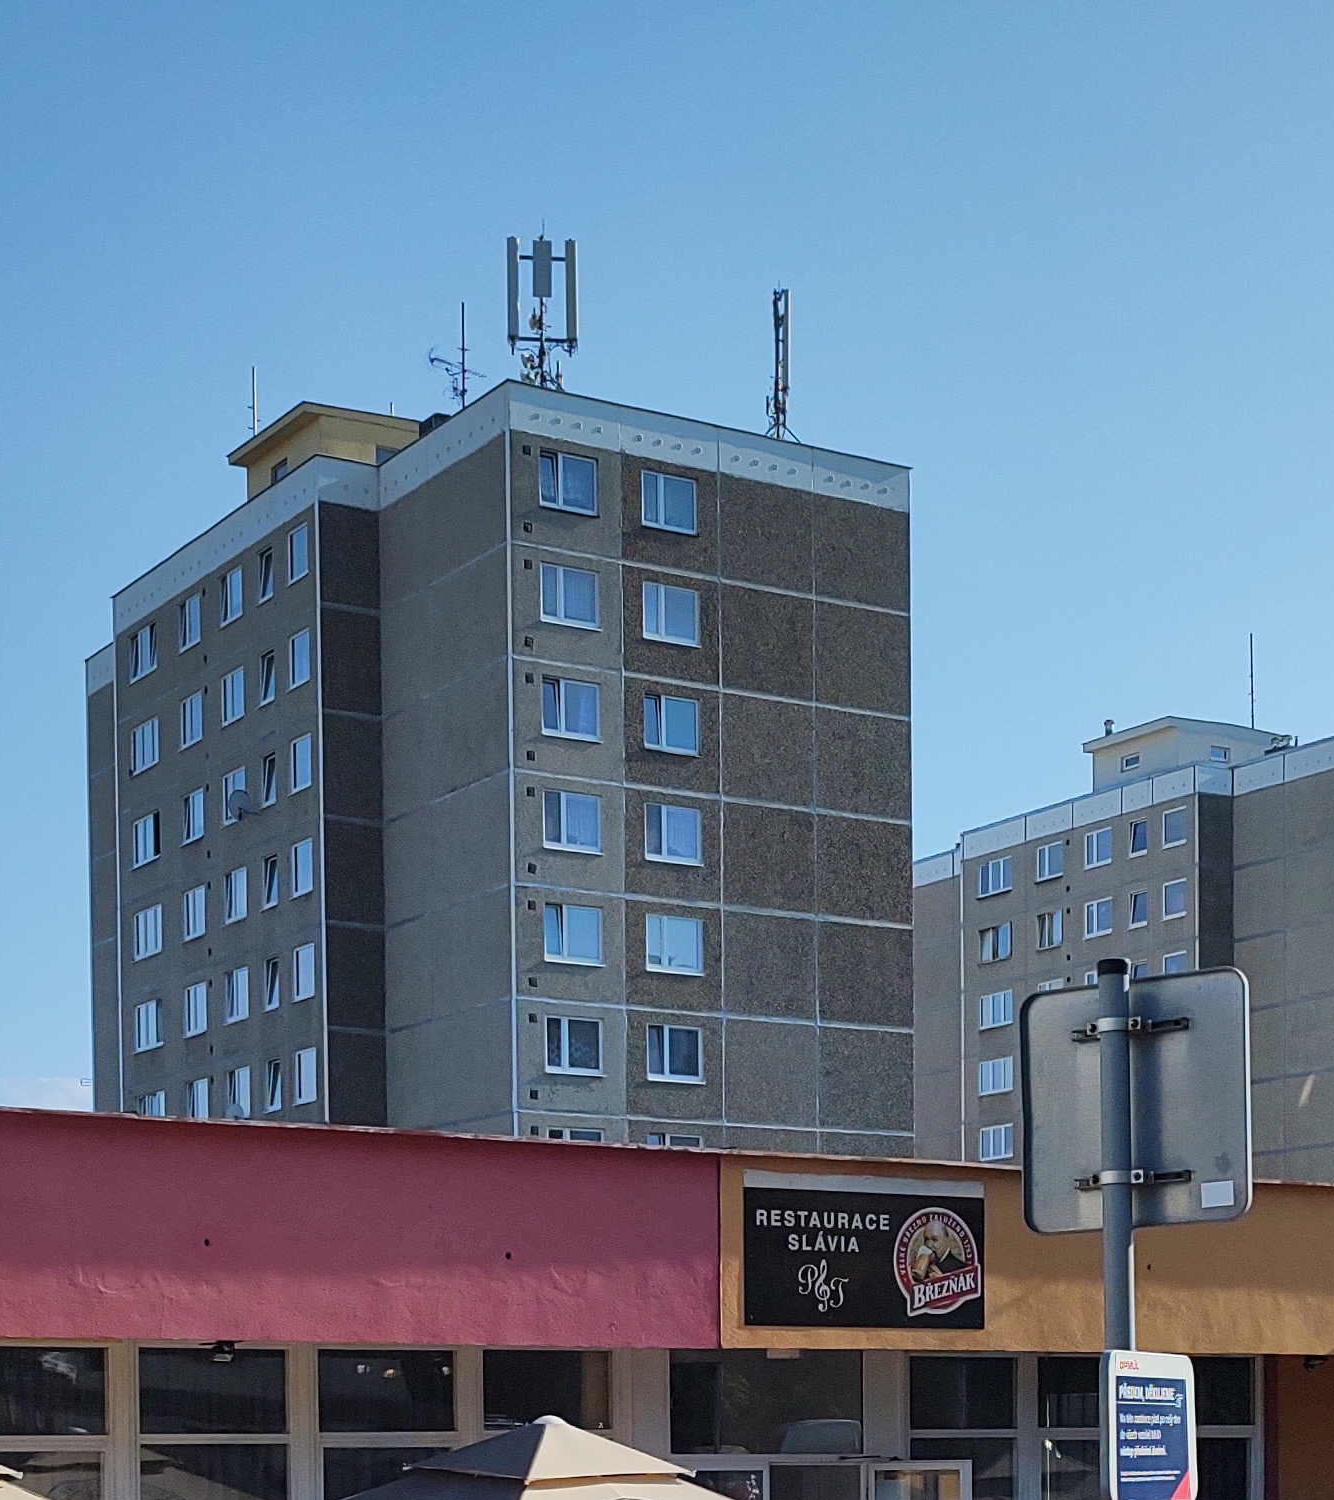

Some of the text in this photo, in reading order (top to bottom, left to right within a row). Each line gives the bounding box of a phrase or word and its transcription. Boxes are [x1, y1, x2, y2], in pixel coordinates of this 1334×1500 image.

[756, 1209, 890, 1231] RESTAURACE
[788, 1231, 859, 1252] SLÁVIA
[913, 1272, 975, 1309] BŘEZŇÁK
